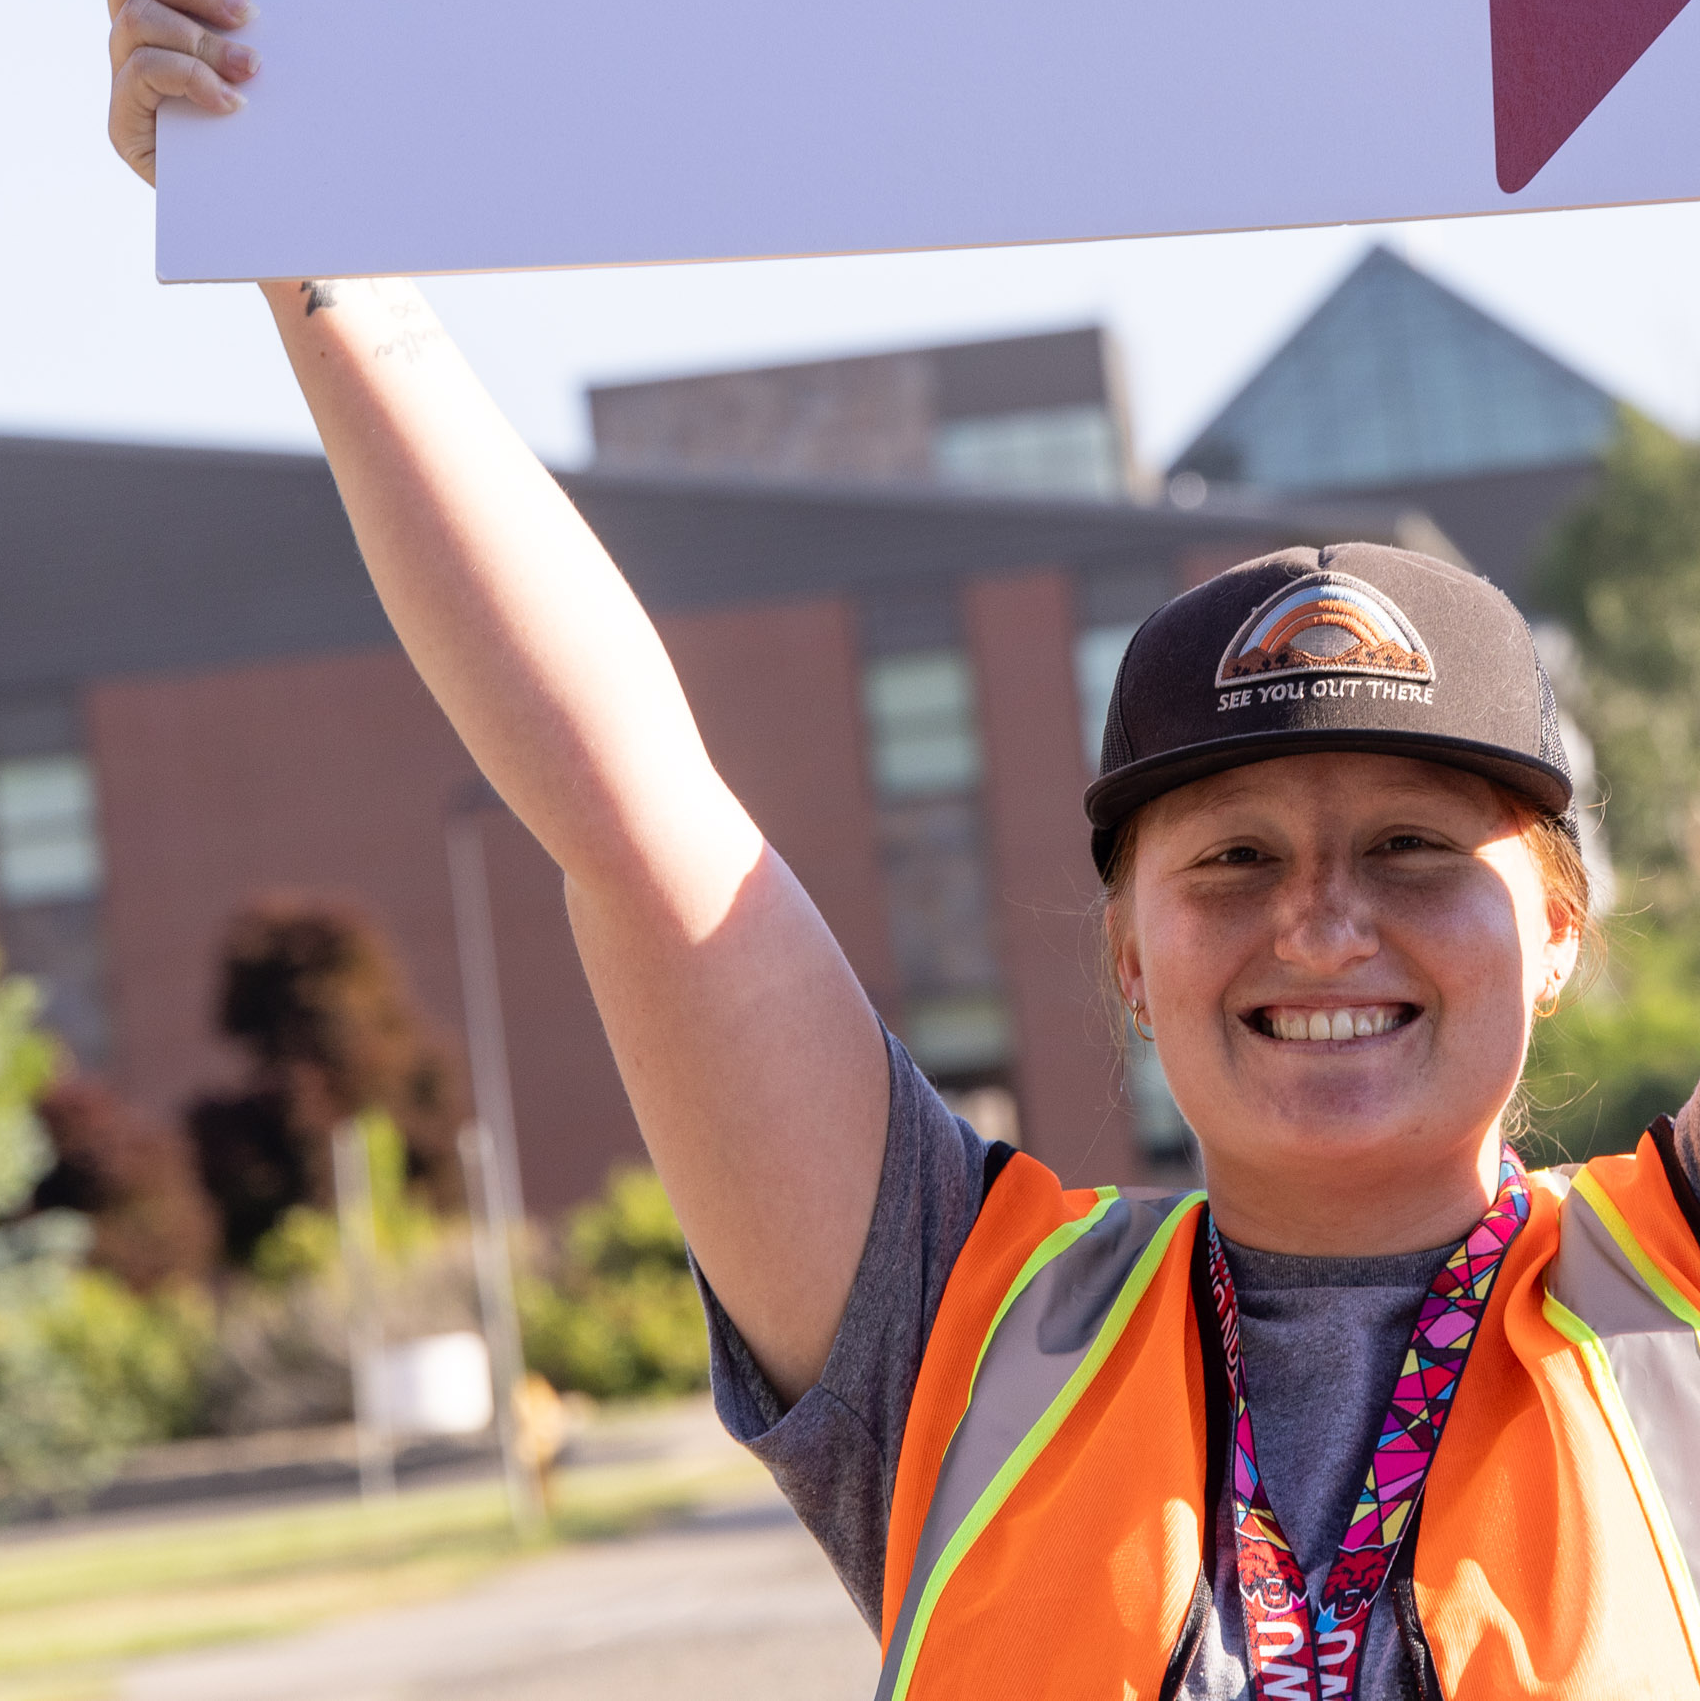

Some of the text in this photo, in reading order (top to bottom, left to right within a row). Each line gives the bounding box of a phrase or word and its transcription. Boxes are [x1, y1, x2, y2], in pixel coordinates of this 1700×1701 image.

[1217, 678, 1435, 712] SEE YOU OUT THERE
